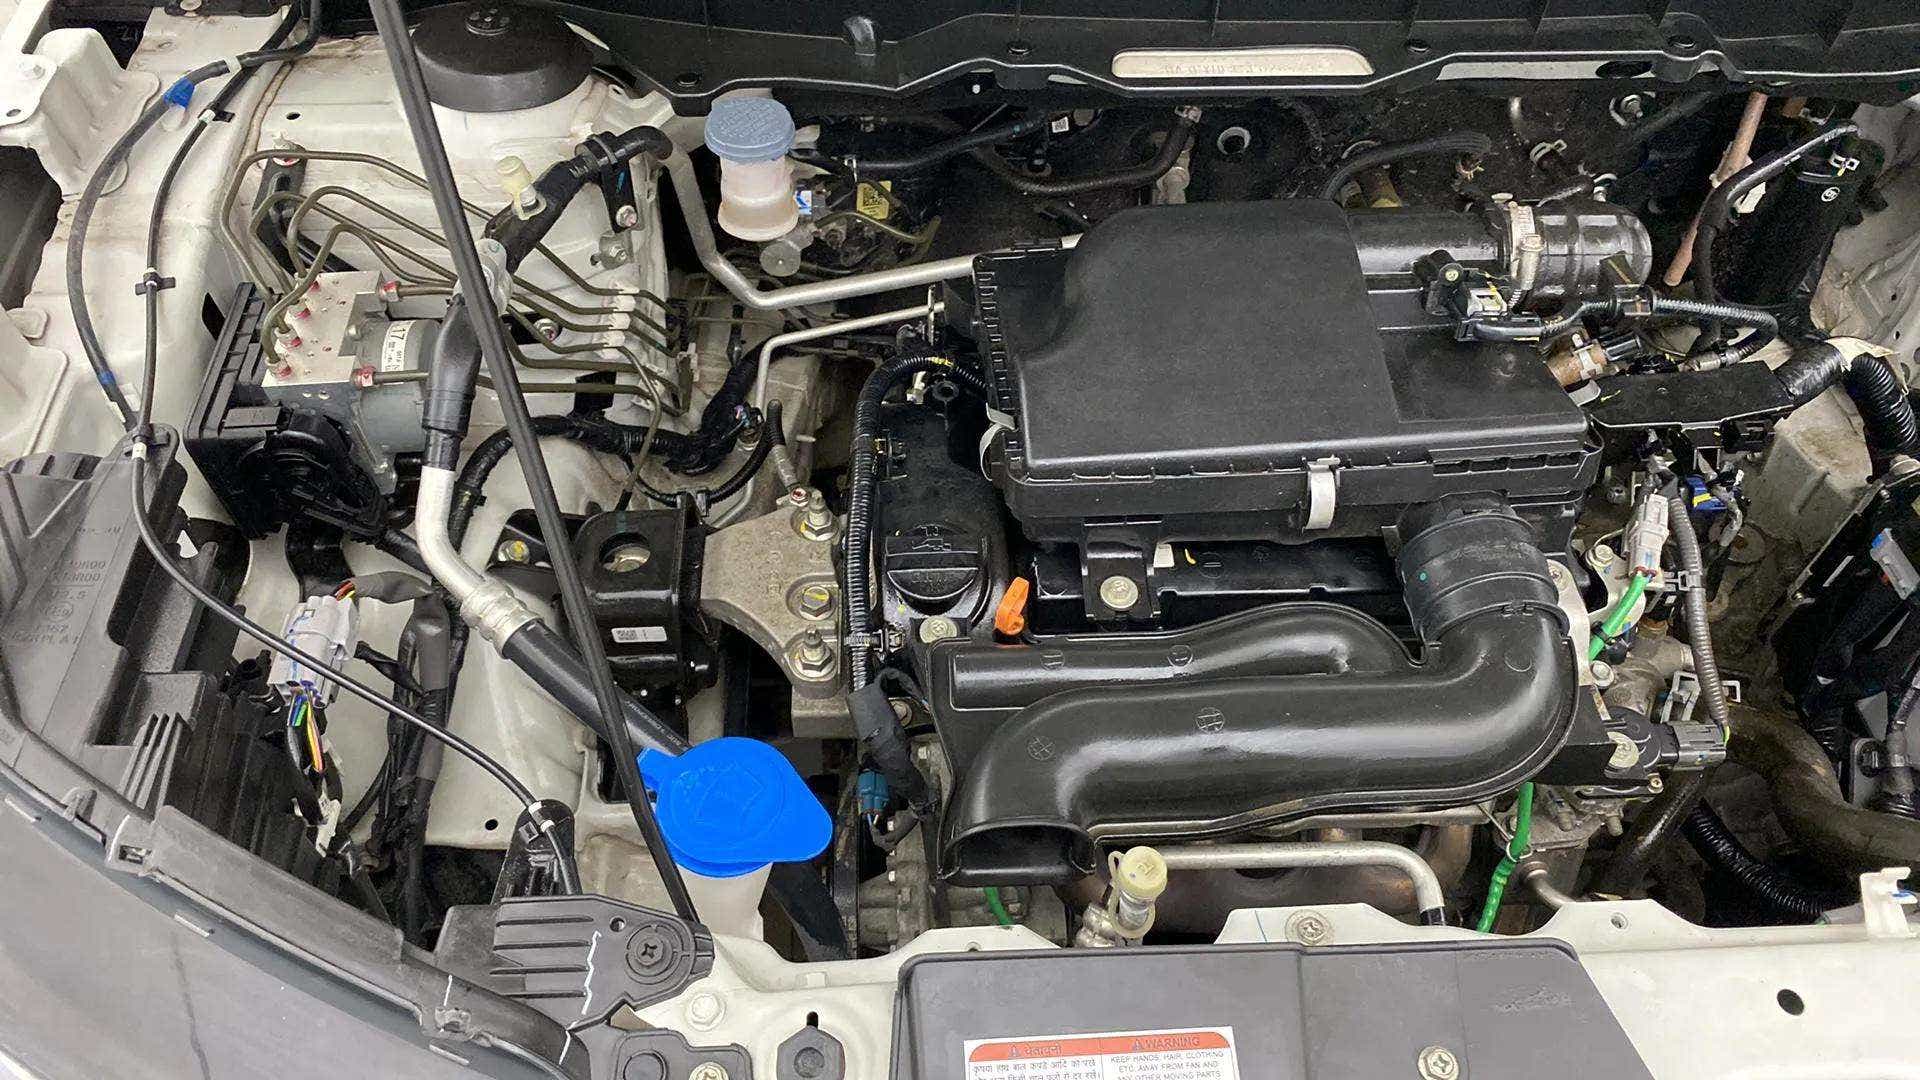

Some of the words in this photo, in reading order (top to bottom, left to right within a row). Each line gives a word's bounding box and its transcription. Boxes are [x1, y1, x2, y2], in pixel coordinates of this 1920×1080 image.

[1146, 1036, 1200, 1050] WARNING
[1110, 1055, 1130, 1063] KEEP
[1185, 1050, 1224, 1059] CLOTHING
[1137, 1063, 1159, 1071] AWAY
[1161, 1062, 1183, 1070] FROM
[1203, 1059, 1219, 1068] AND
[1196, 1069, 1222, 1079] PARTS
